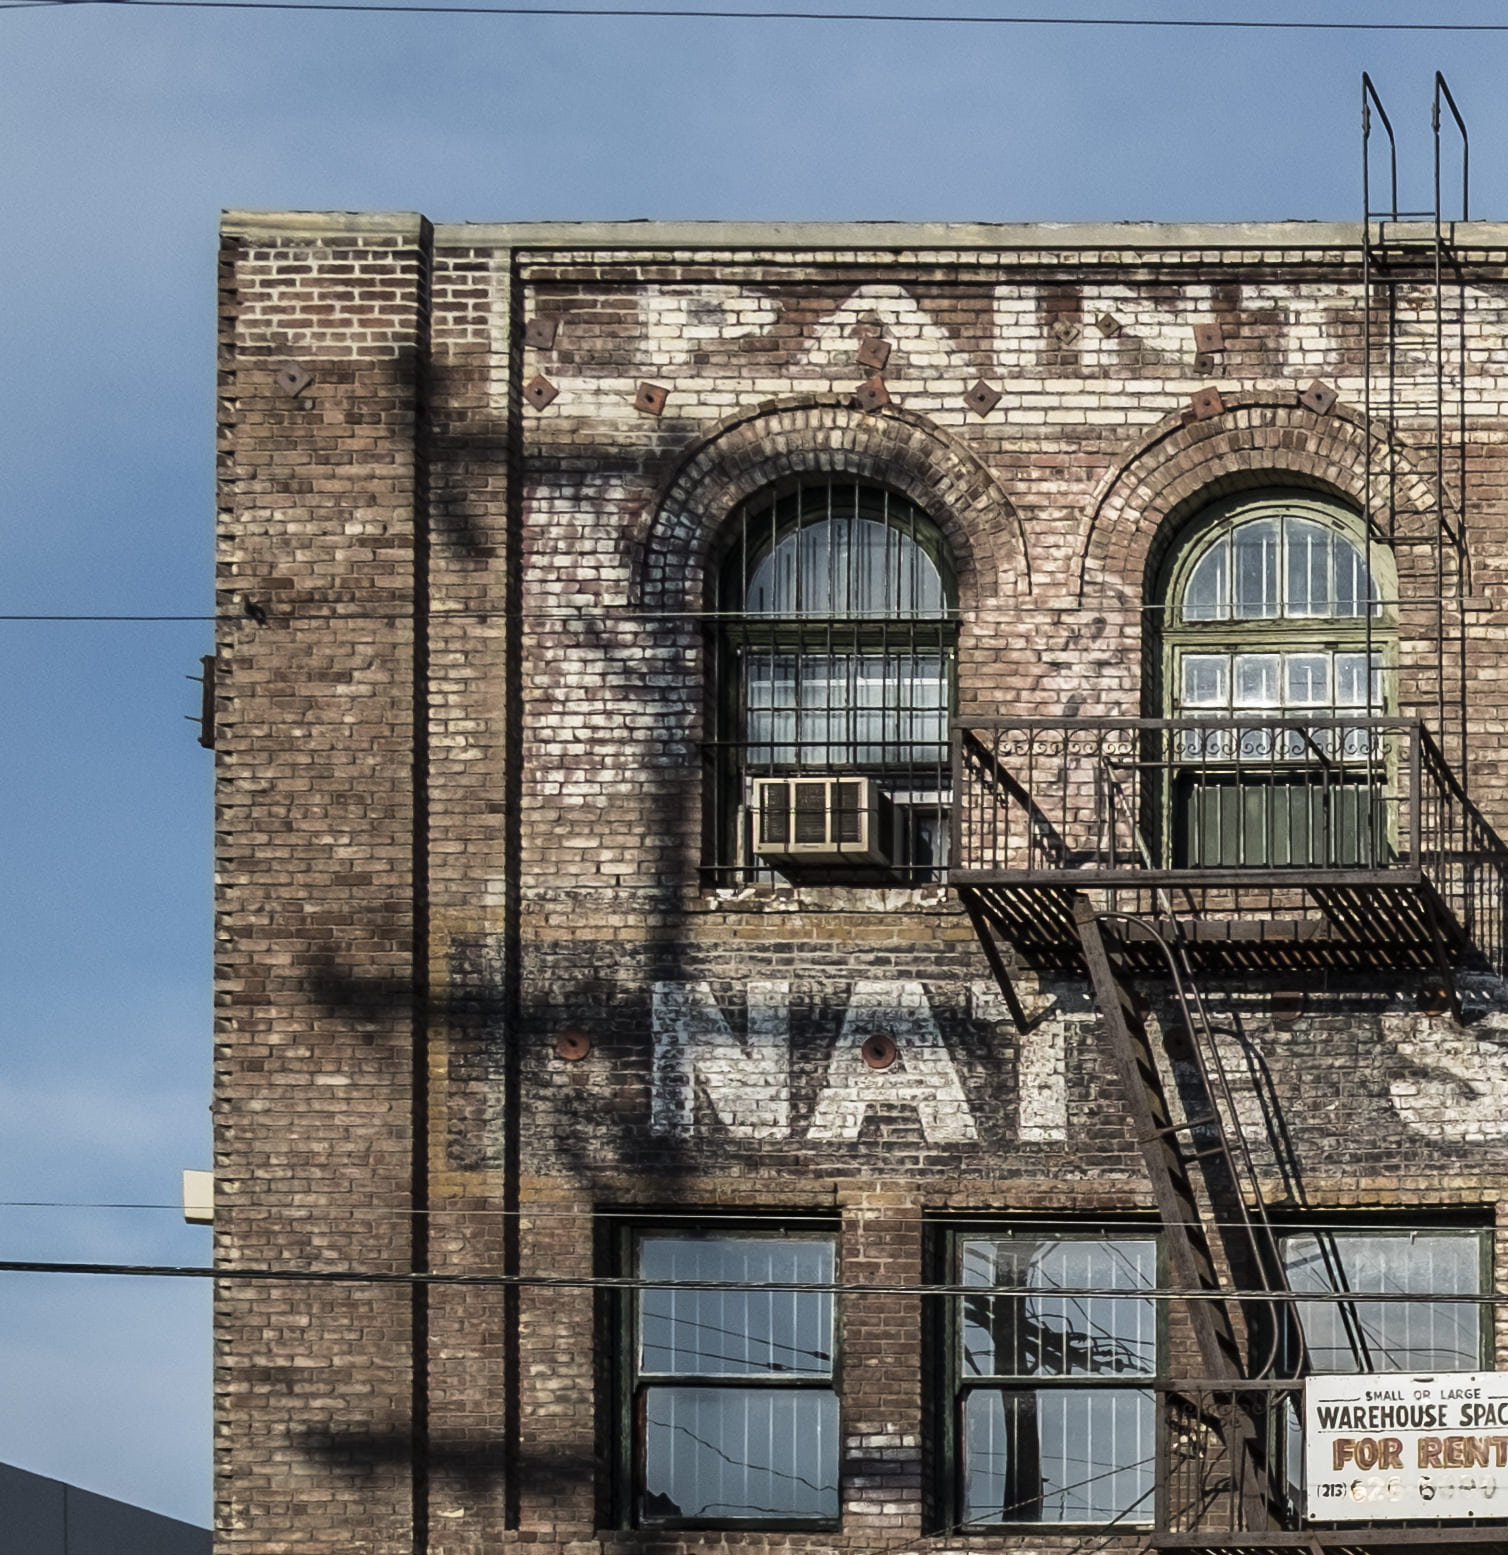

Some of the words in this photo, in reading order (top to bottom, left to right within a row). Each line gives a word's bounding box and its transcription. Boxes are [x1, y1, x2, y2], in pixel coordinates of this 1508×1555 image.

[1365, 1389, 1405, 1402] SMALL
[1413, 1389, 1432, 1401] OR
[1440, 1387, 1482, 1400] LARGE
[1316, 1403, 1448, 1431] WAREHOUSE
[1332, 1436, 1405, 1472] FOR
